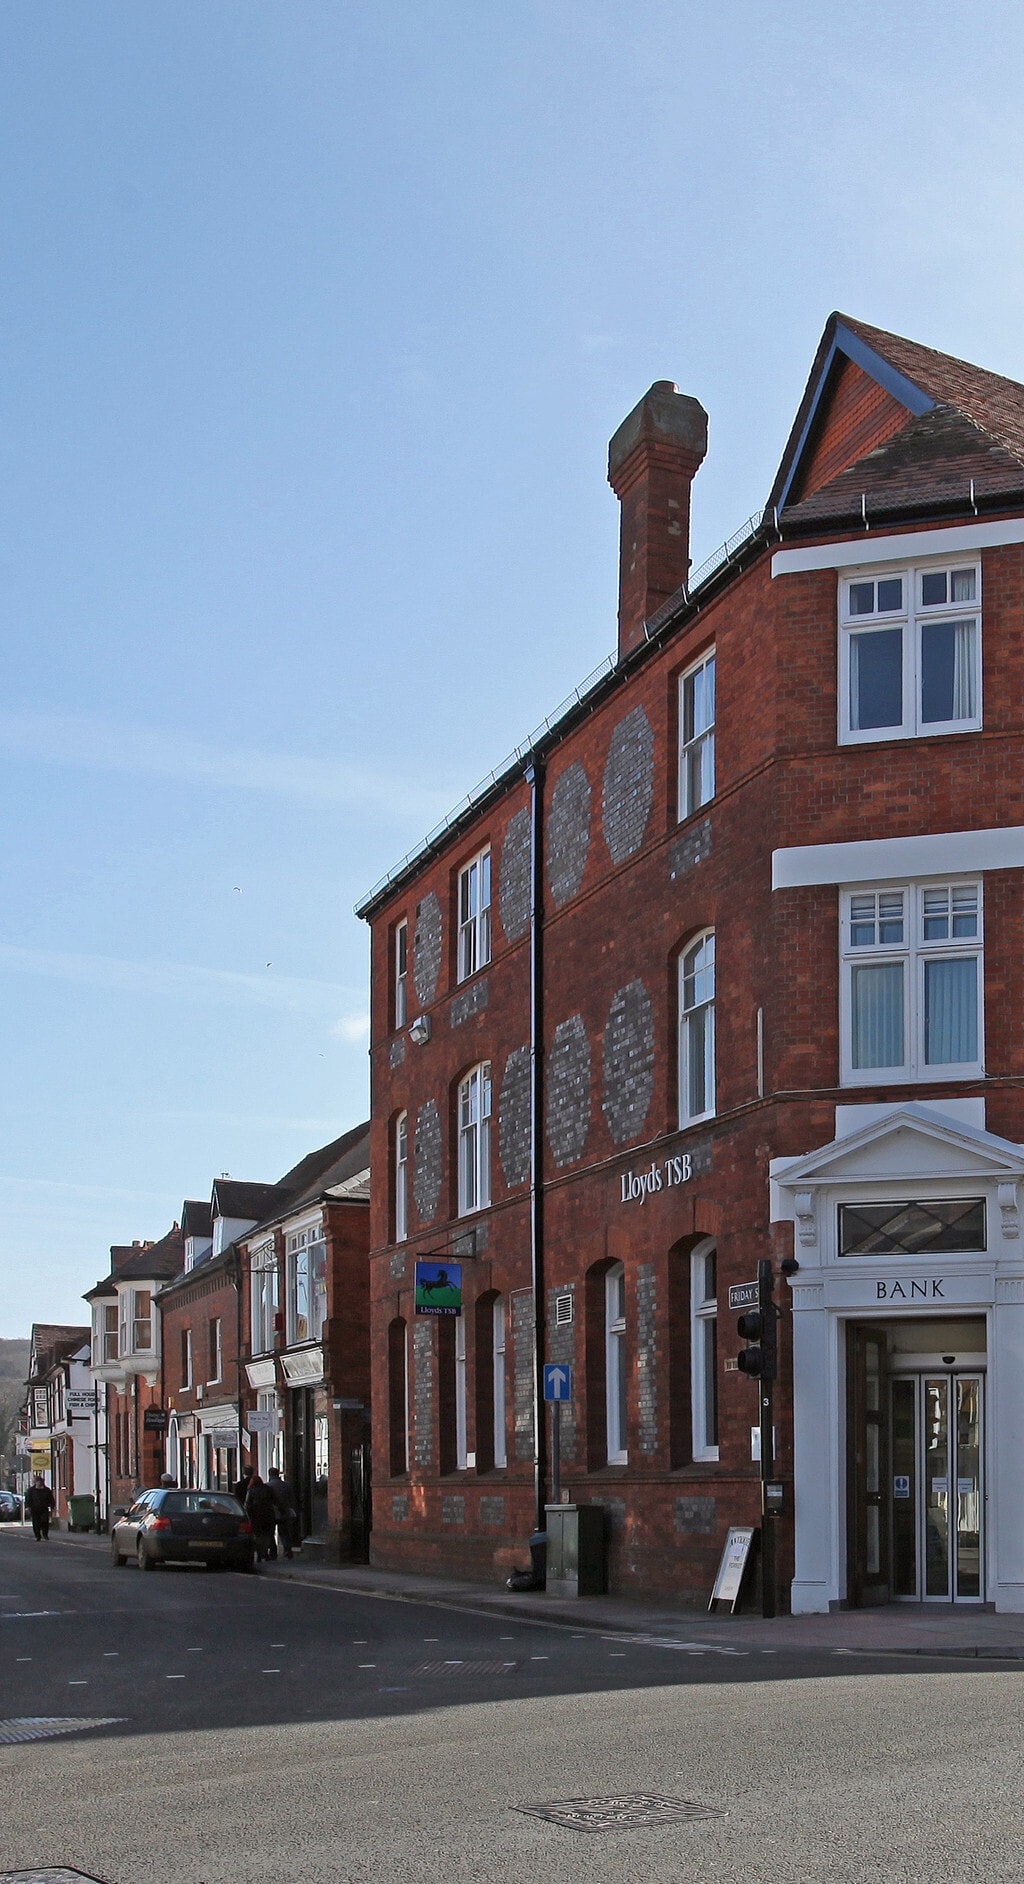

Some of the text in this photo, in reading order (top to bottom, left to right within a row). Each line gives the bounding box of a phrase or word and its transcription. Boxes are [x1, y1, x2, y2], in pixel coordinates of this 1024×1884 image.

[620, 1153, 693, 1206] Lloyds TSB
[731, 1288, 753, 1303] FRIDAY
[876, 1279, 946, 1299] BANK
[420, 1306, 457, 1315] Lloyds TSB
[763, 1398, 770, 1407] 3
